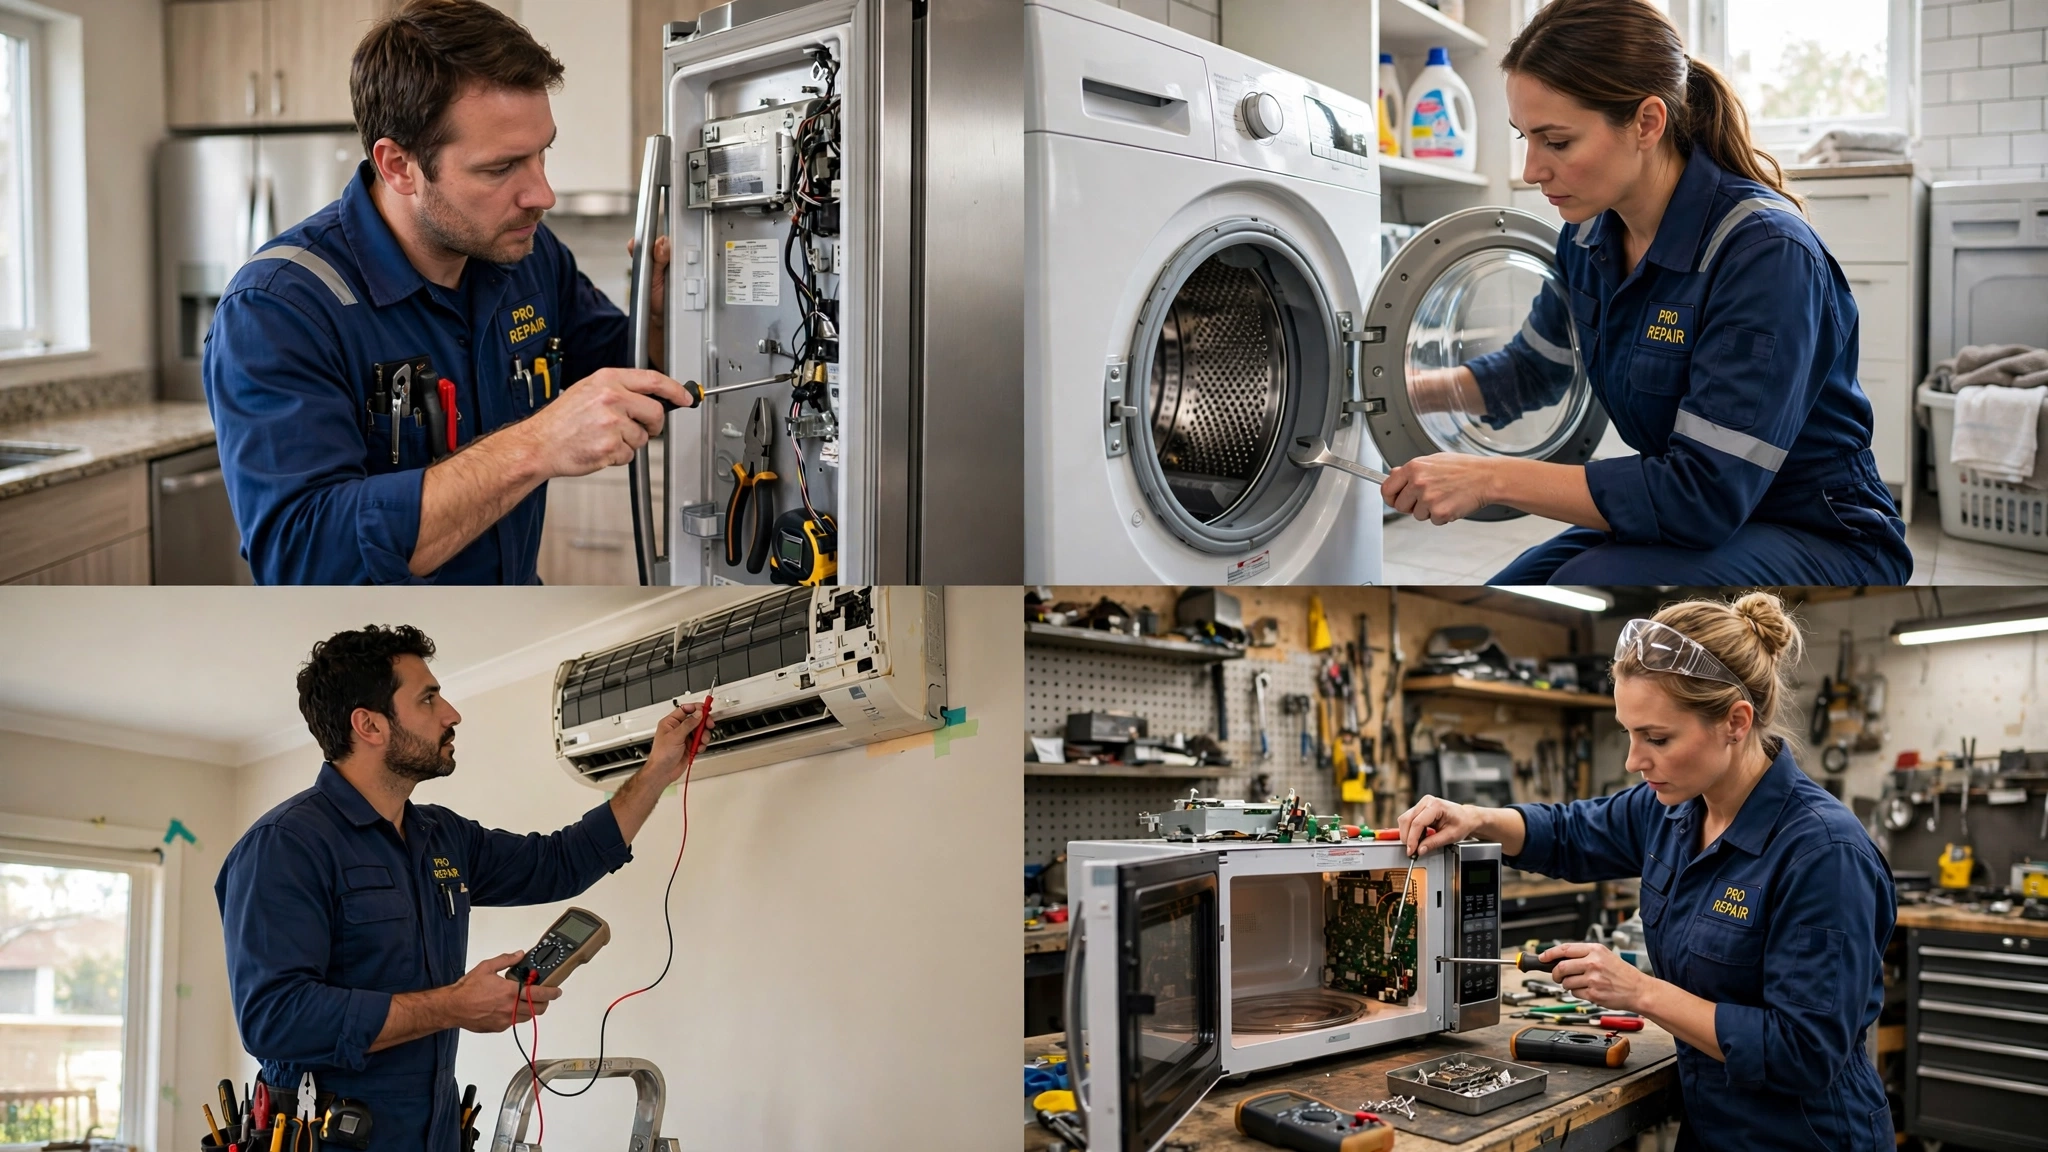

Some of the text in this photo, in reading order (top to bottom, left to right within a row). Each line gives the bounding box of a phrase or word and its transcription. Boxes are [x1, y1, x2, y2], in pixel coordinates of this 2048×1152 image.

[511, 304, 535, 325] PRO
[1657, 309, 1679, 325] PRO
[509, 316, 547, 344] REPAIR
[1646, 325, 1685, 345] REPAIR
[1724, 886, 1746, 902] PRO
[1712, 899, 1749, 920] REPAIR
